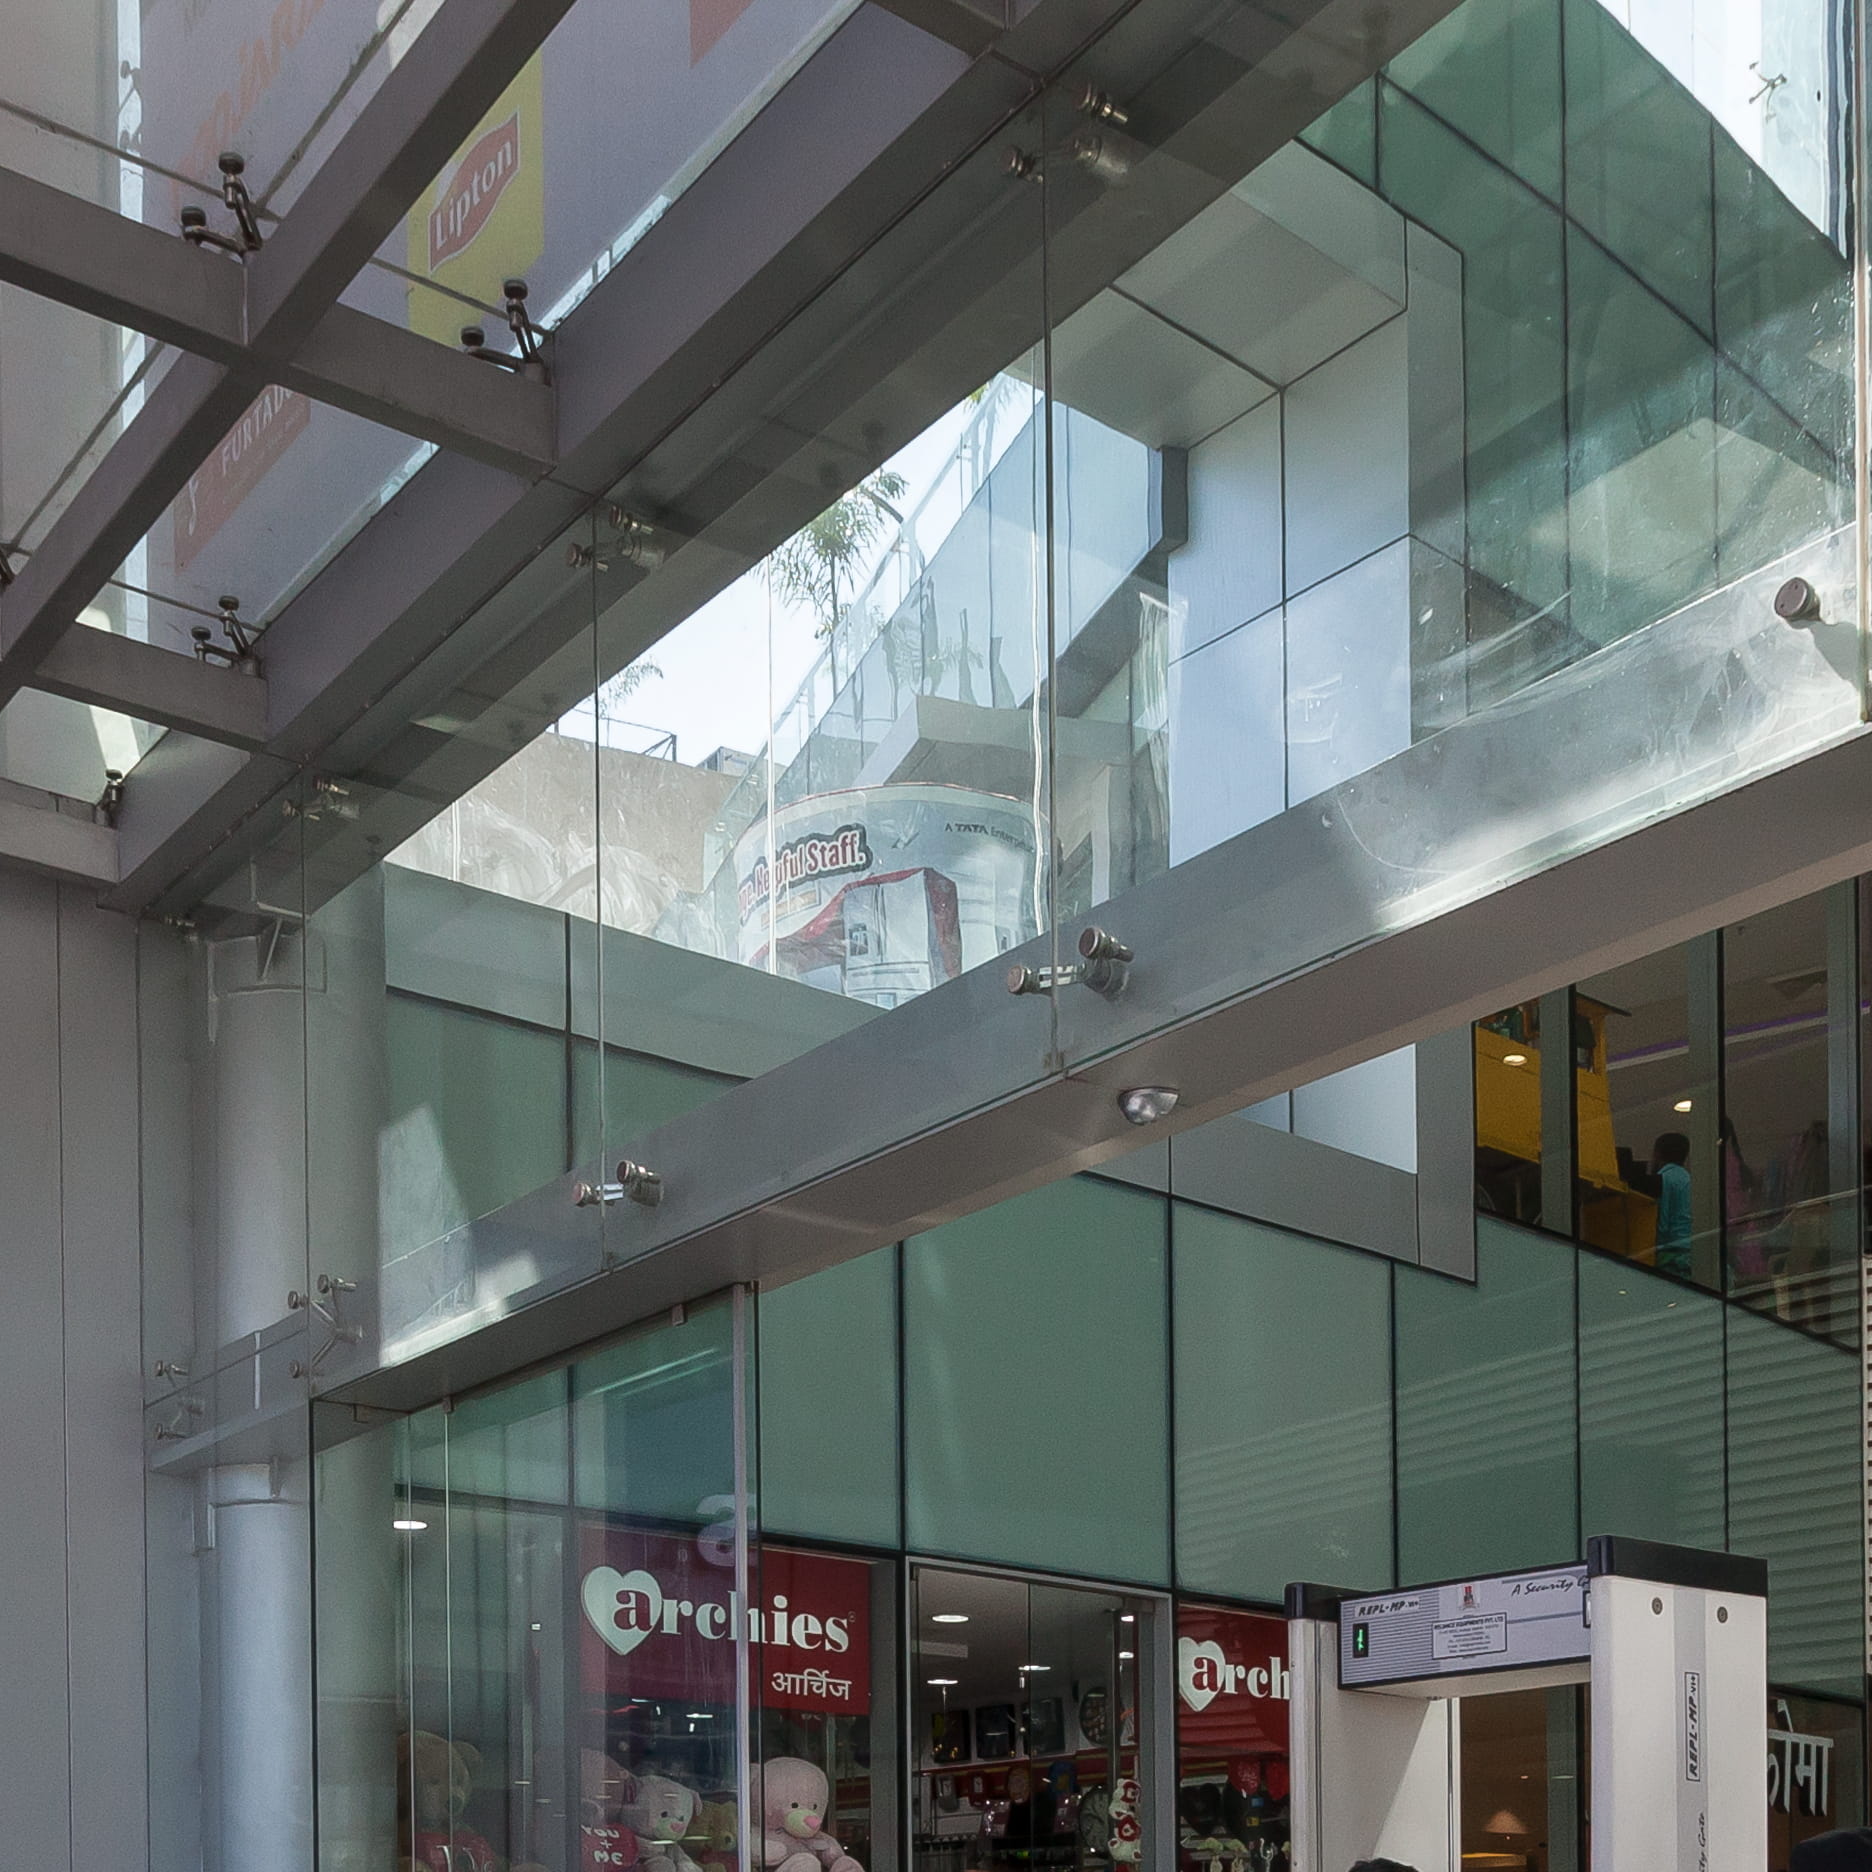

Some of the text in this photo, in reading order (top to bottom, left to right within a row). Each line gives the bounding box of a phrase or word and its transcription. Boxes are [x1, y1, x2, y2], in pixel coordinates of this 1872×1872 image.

[434, 138, 513, 251] Lipton
[955, 823, 989, 836] TATA
[755, 832, 866, 895] Hepful Staff.
[1524, 1578, 1574, 1596] Security
[613, 1587, 850, 1653] archies
[771, 1668, 853, 1700] आर्चिज
[594, 1850, 623, 1866] ME
